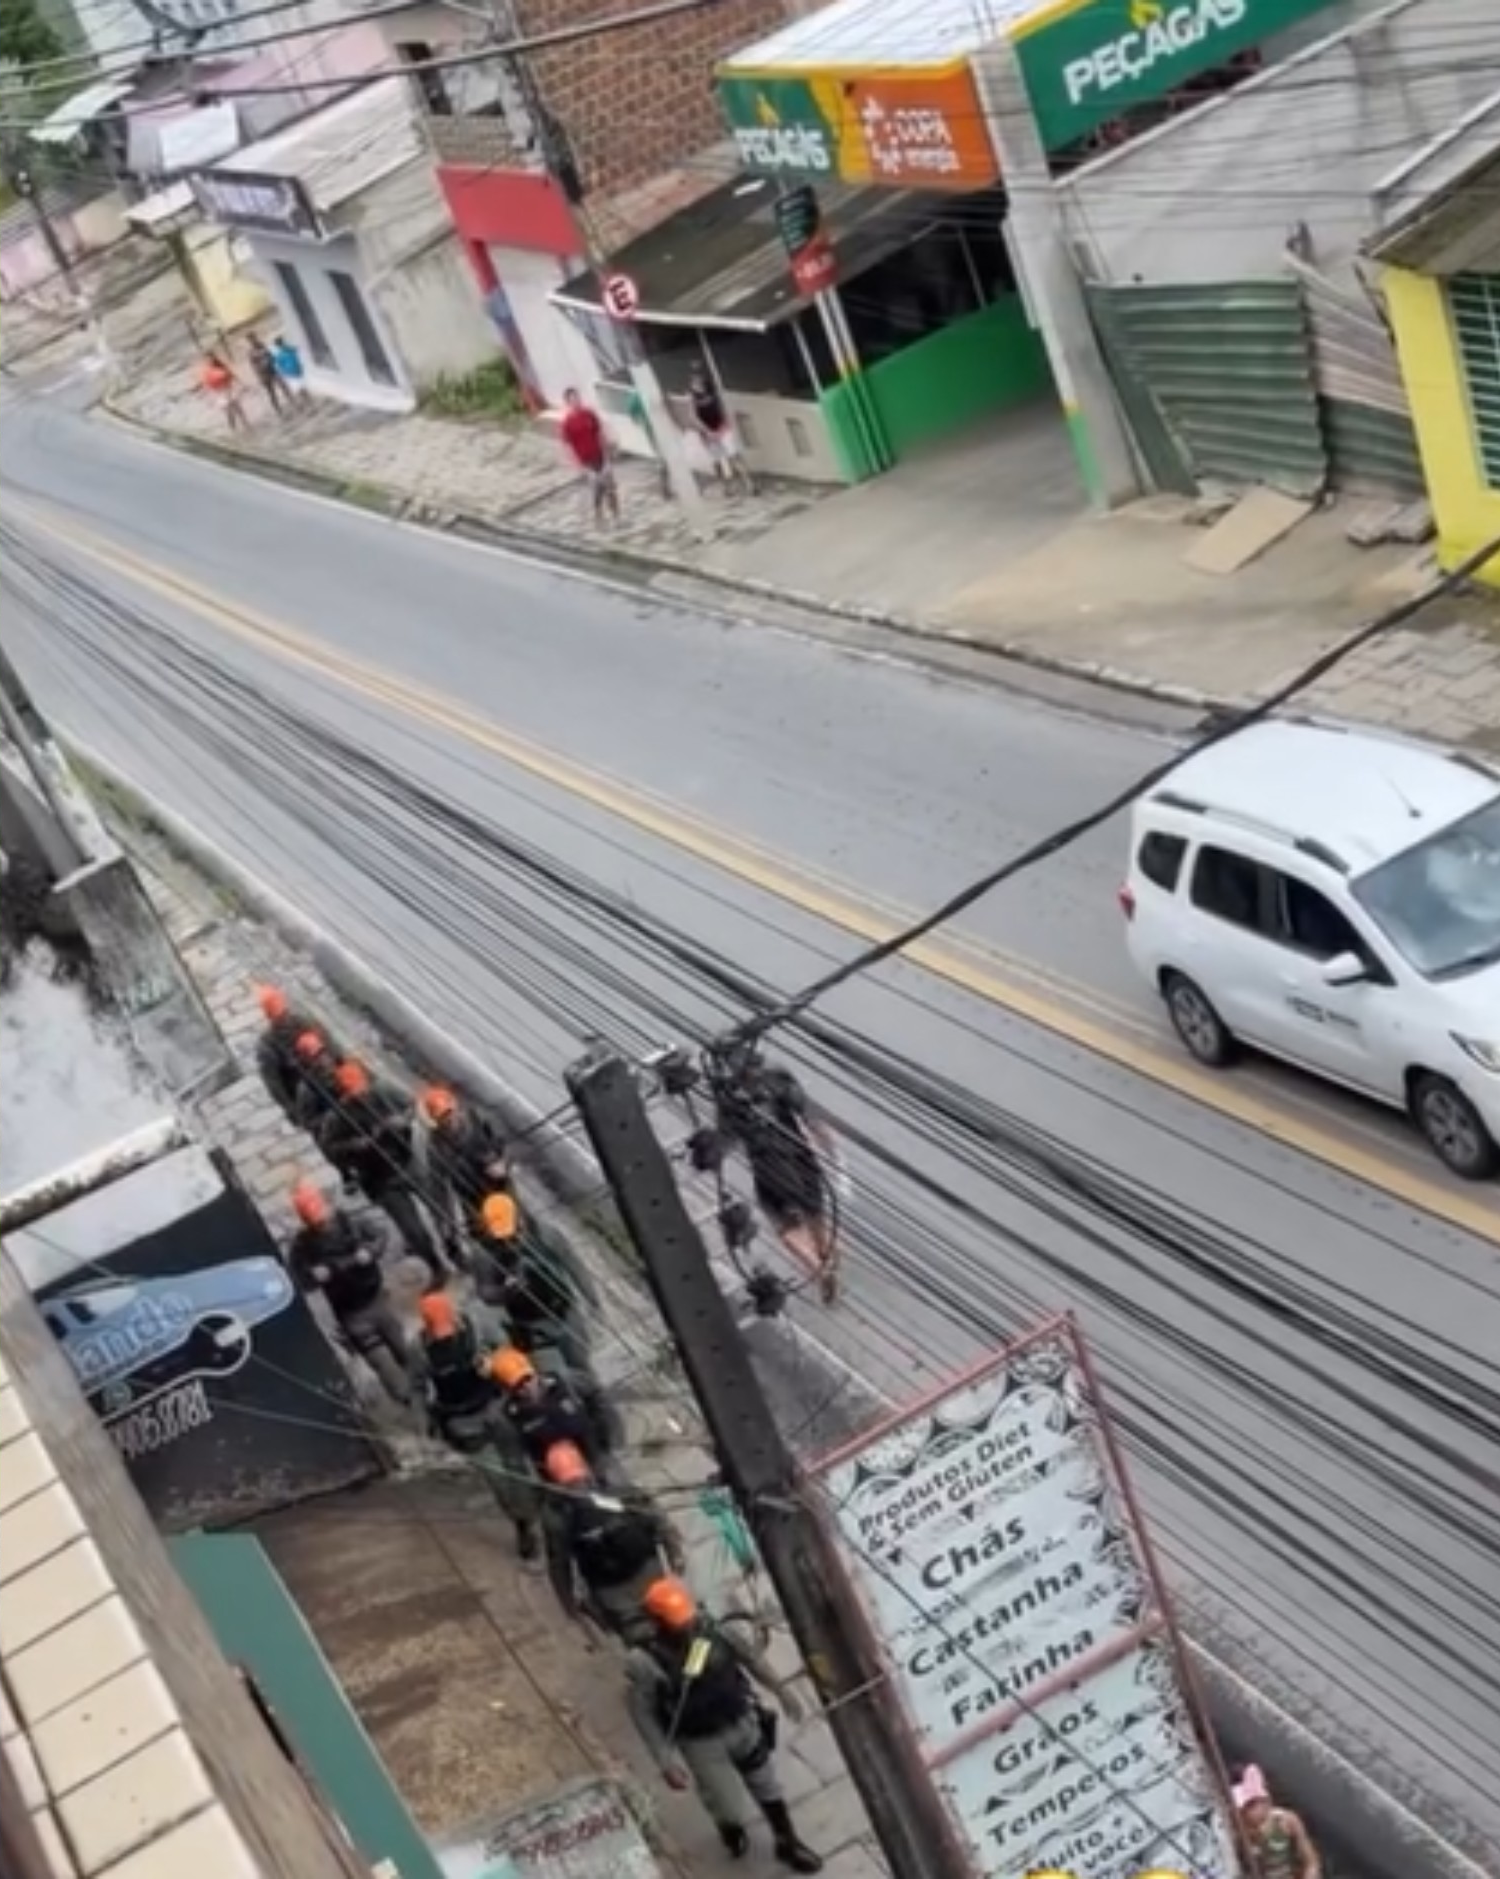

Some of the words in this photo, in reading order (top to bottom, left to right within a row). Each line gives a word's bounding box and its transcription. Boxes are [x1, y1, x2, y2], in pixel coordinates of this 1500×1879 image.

[858, 1457, 971, 1537] Produtos
[976, 1421, 1031, 1463] Diet
[889, 1500, 942, 1537] Sem
[921, 1516, 1025, 1591] Chás
[908, 1561, 1084, 1677] Castanha
[951, 1629, 1093, 1727] Farinha
[987, 1741, 1145, 1847] Temperos
